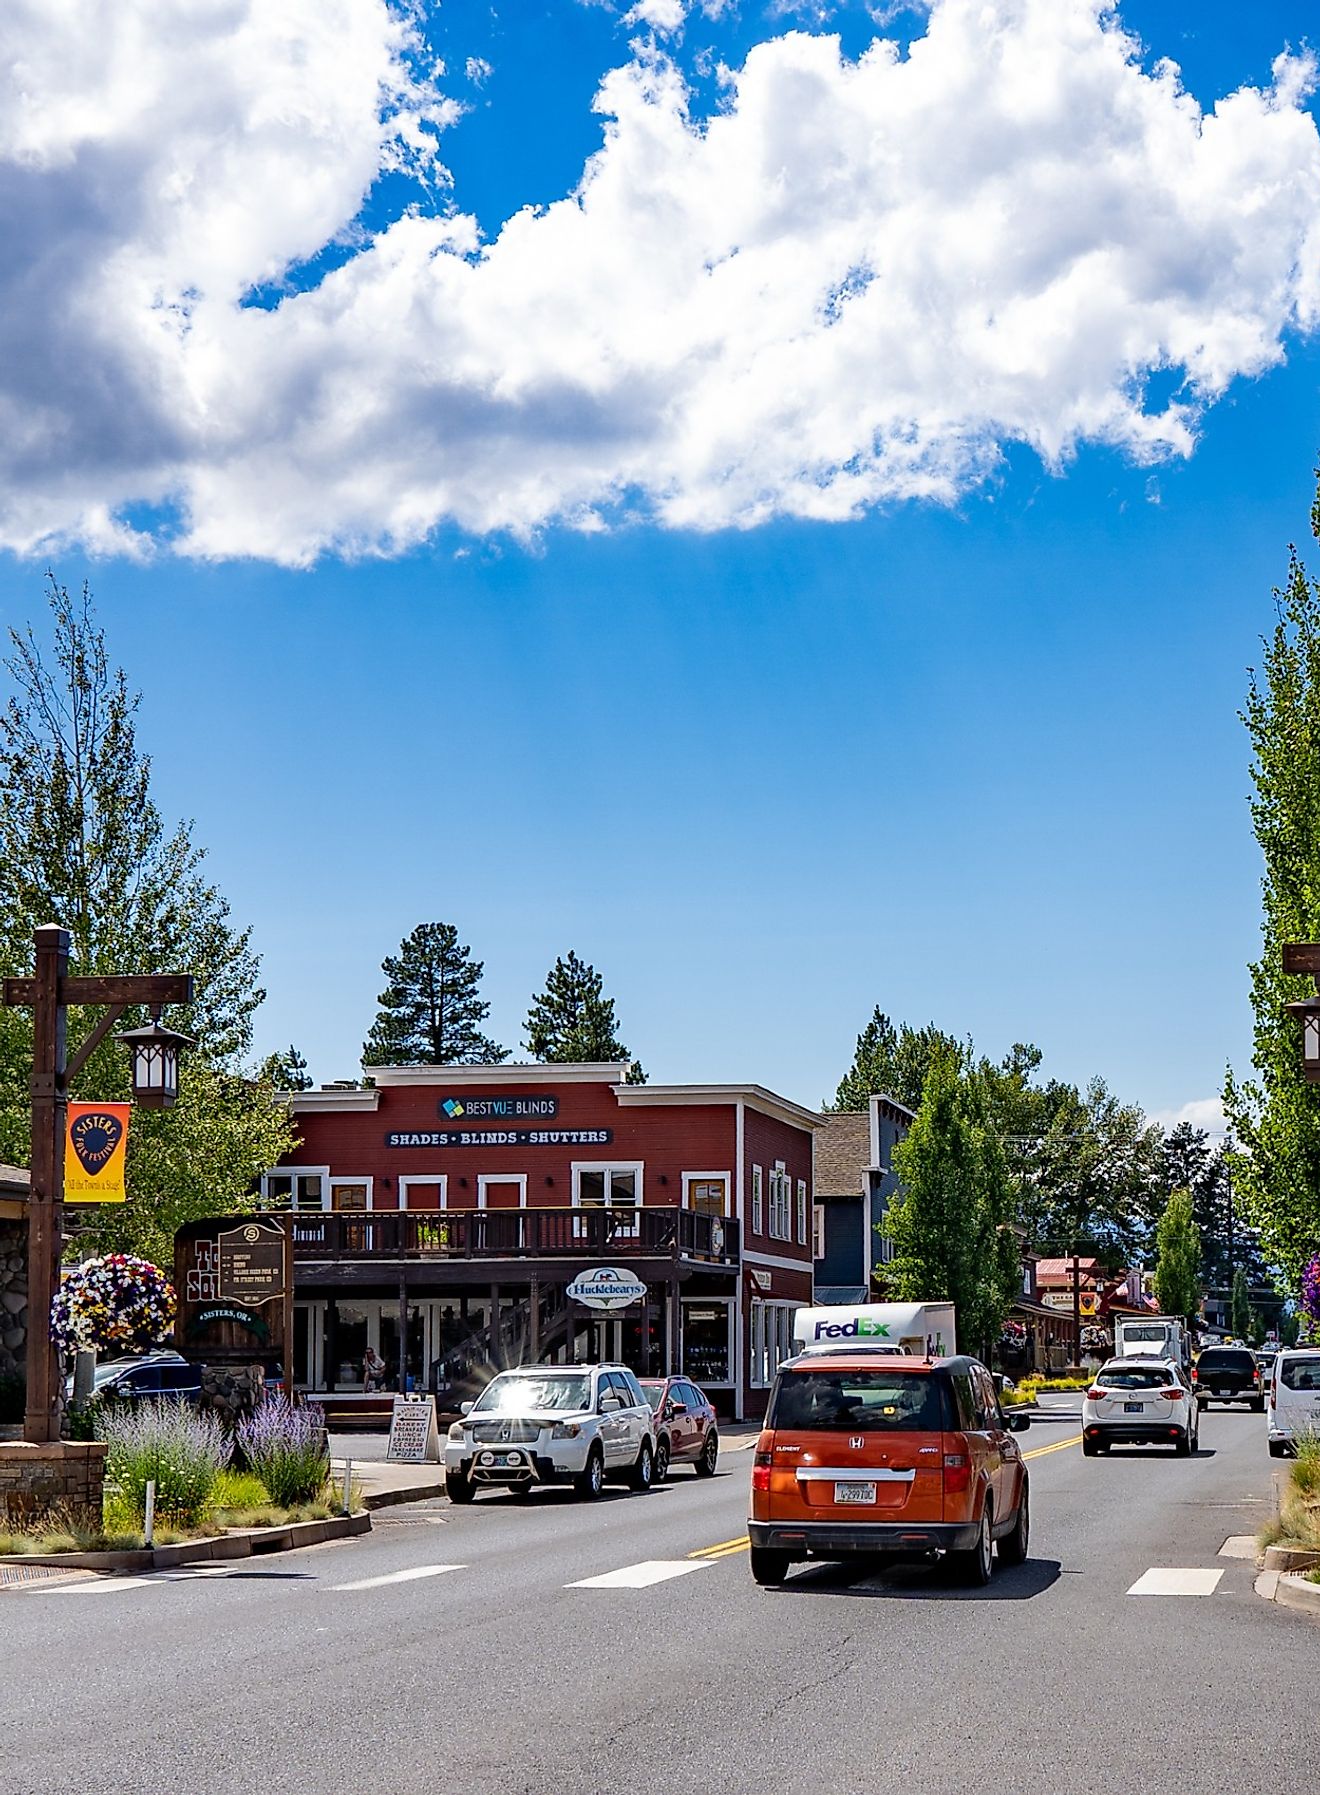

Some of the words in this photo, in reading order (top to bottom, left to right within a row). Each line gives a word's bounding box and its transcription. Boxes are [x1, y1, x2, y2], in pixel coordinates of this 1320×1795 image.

[466, 1101, 513, 1115] BESTVUE
[516, 1100, 555, 1114] BLINDS
[76, 1116, 117, 1135] SISTERS
[76, 1137, 88, 1158] FOLK
[390, 1133, 448, 1145] SHADES
[460, 1132, 517, 1145] BLINDS
[529, 1131, 608, 1144] SHUTTERS
[88, 1137, 115, 1161] FESTIVAL
[814, 1317, 890, 1340] FedEx
